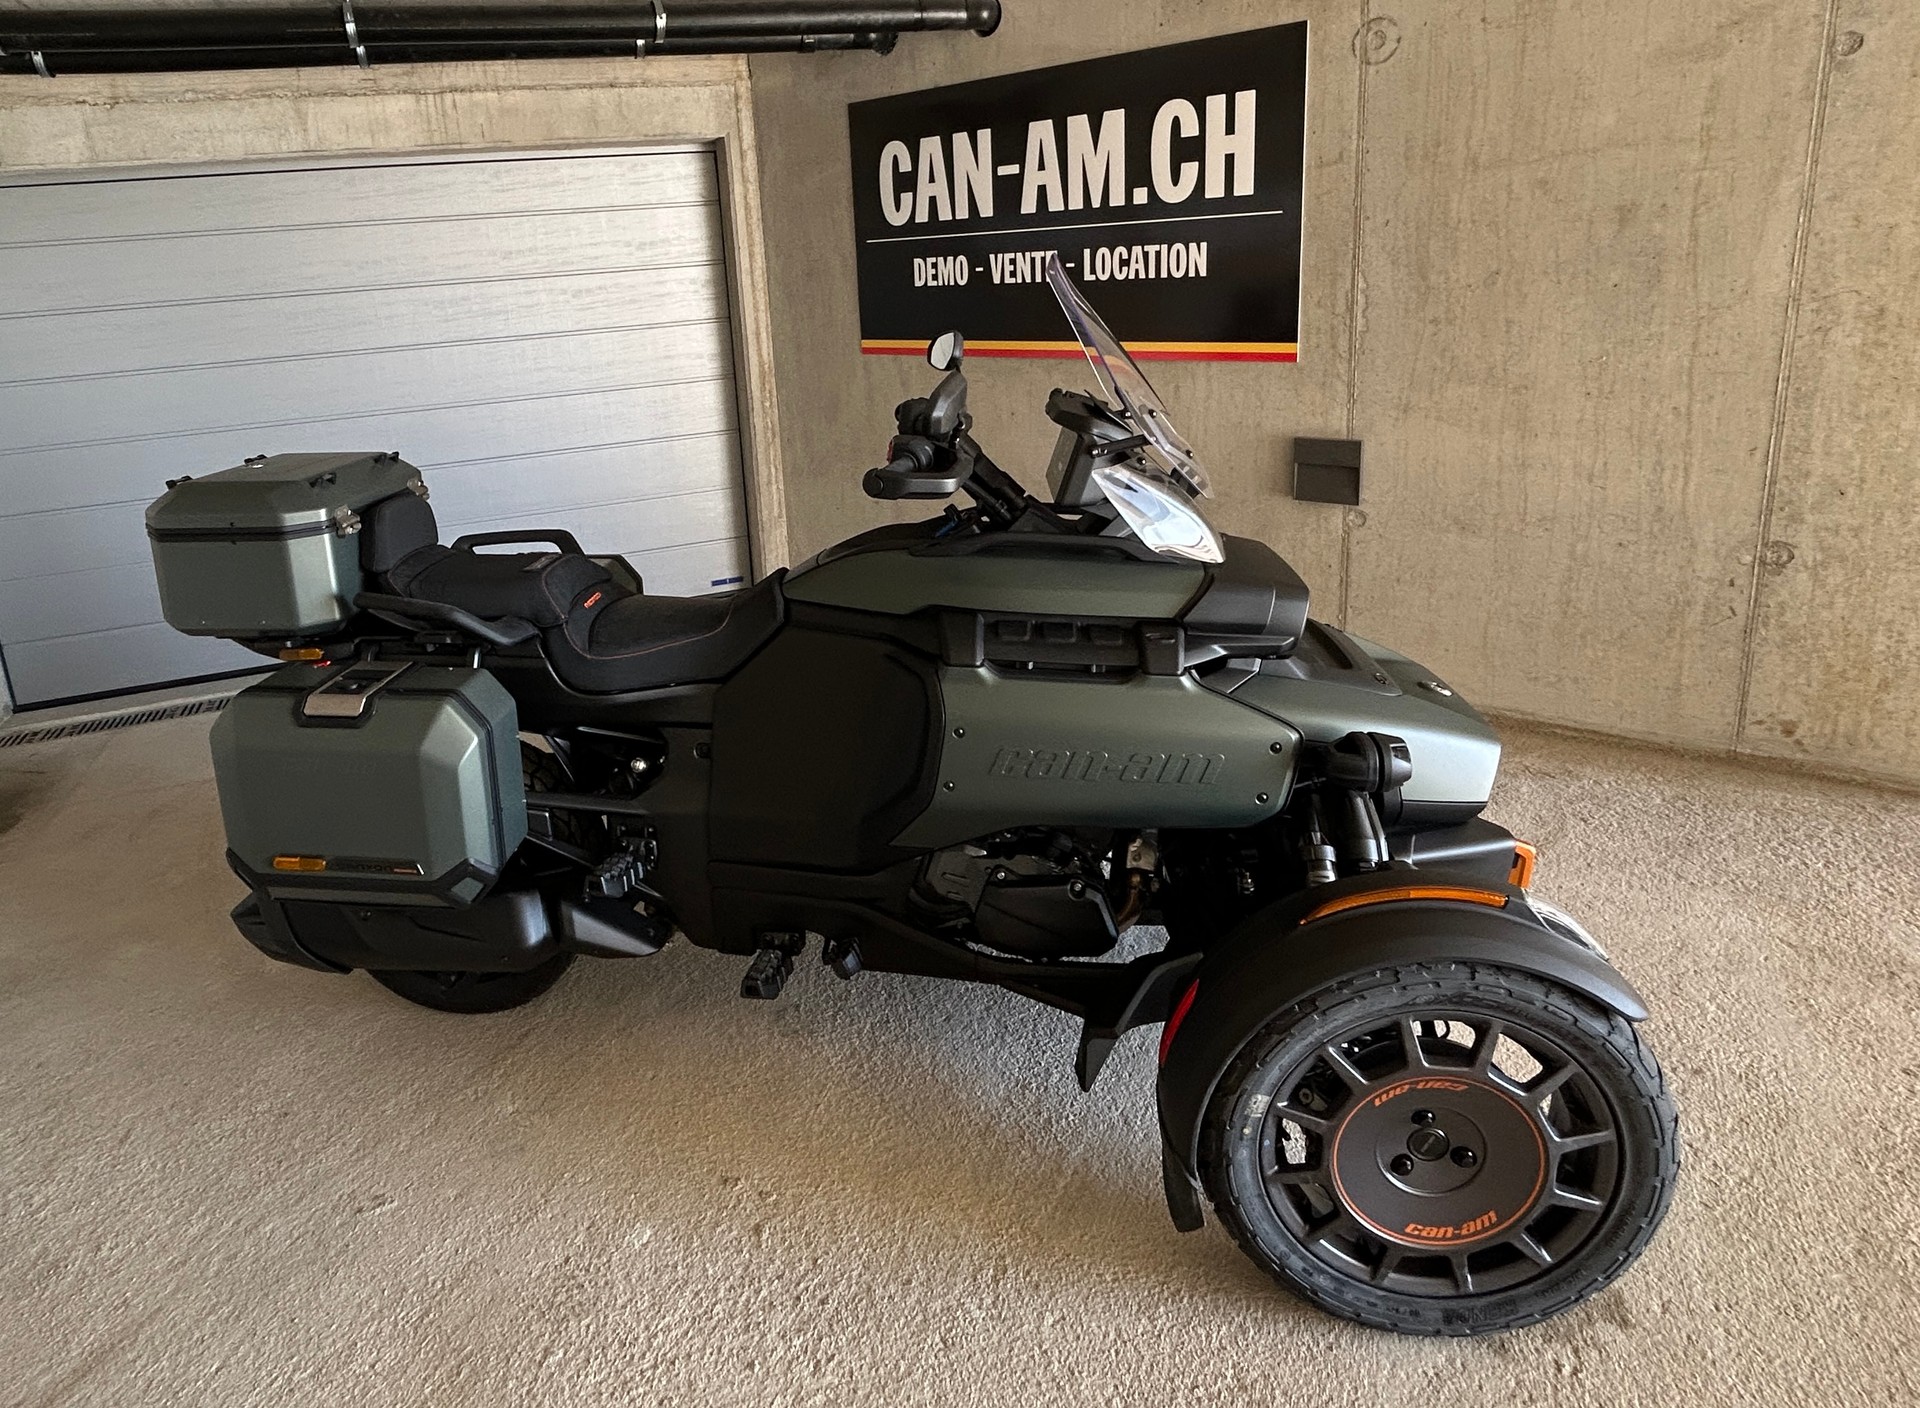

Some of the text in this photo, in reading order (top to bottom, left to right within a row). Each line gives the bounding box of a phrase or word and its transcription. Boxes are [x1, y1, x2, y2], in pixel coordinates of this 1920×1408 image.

[879, 89, 1257, 227] CAN-AM.CH
[913, 255, 969, 287] DEMO
[1083, 241, 1208, 281] LOCATION
[988, 748, 1225, 784] can-am
[1374, 1080, 1470, 1107] can-am
[1404, 1210, 1498, 1239] can-am
